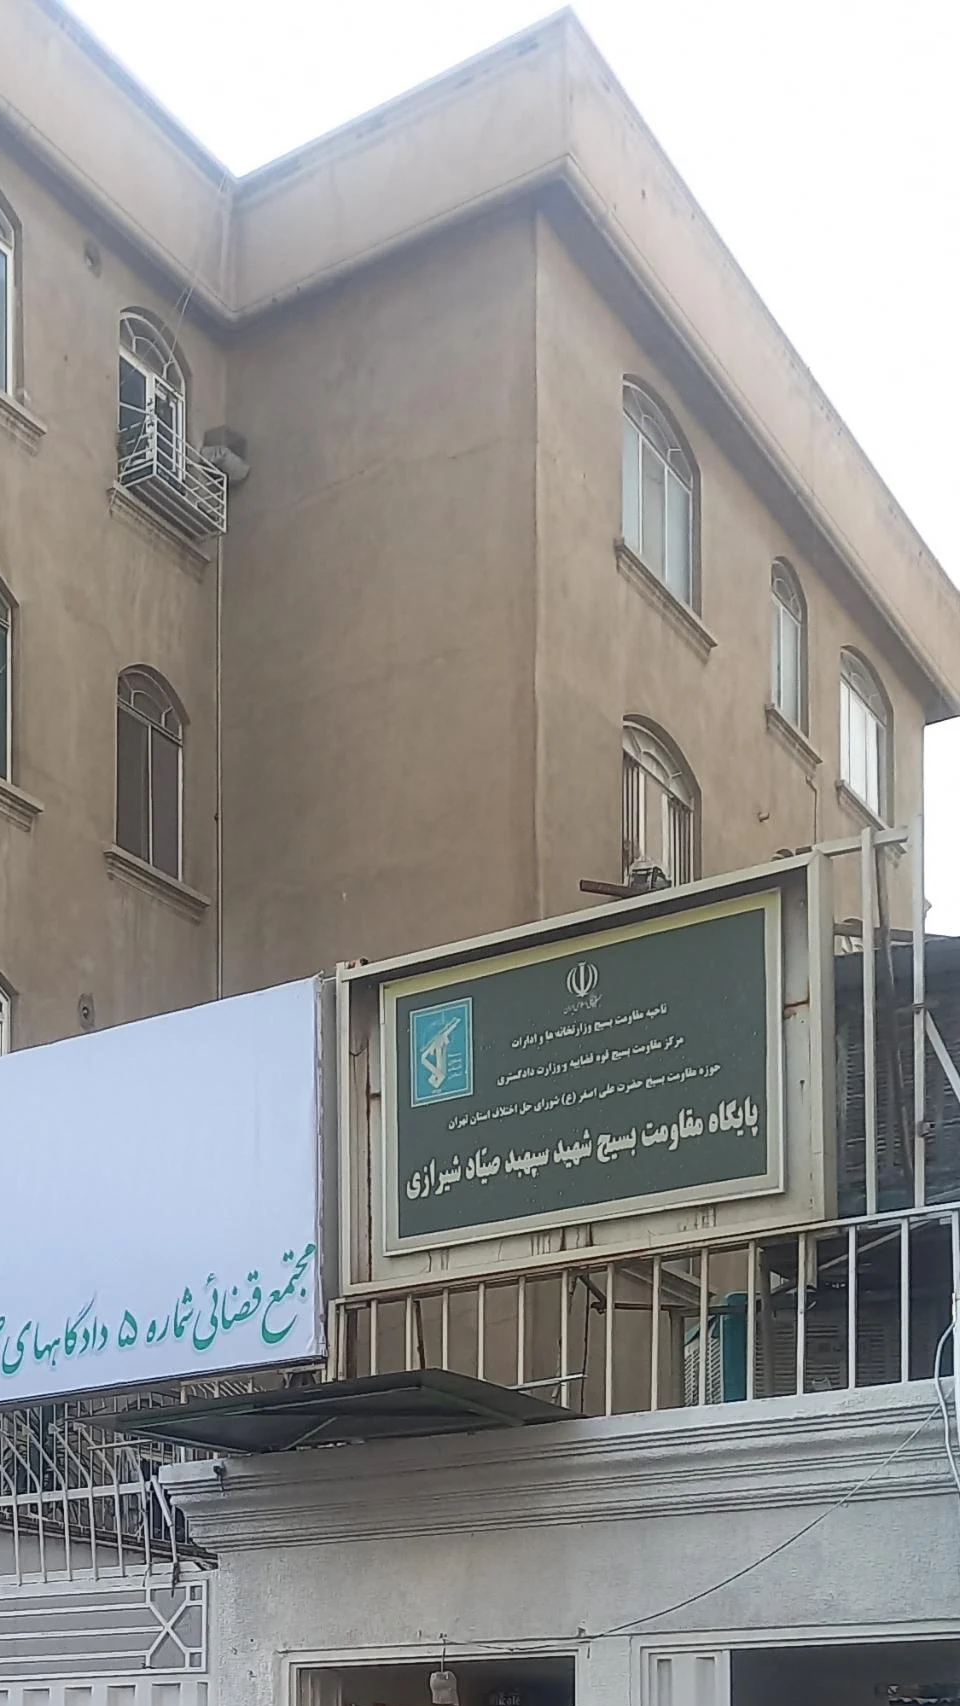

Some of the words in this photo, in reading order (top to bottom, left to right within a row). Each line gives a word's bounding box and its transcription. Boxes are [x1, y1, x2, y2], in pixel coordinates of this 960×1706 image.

[614, 1010, 644, 1025] مقاومت
[645, 1003, 668, 1020] ناحیه
[594, 1018, 613, 1032] بسیج
[511, 1033, 538, 1049] ادارات
[631, 1039, 662, 1055] مقاومت
[663, 1035, 685, 1051] مرکز
[595, 1048, 609, 1064] قوه
[611, 1047, 631, 1061] بسیج
[496, 1066, 535, 1086] دادگستری
[536, 1062, 561, 1077] وزارت
[667, 1067, 697, 1082] مقاومت
[699, 1064, 721, 1078] حوزه
[616, 1080, 643, 1094] حضرت
[645, 1076, 665, 1089] بسیج
[561, 1091, 577, 1106] (ع)
[598, 1083, 615, 1099] علی
[492, 1104, 518, 1118] اختلاف
[519, 1102, 533, 1115] حل
[533, 1096, 560, 1112] شورای
[448, 1114, 469, 1130] تهران
[470, 1110, 491, 1125] استان
[708, 1095, 759, 1137] پایگاه
[641, 1108, 704, 1151] مقاومت
[553, 1128, 592, 1168] شهید
[596, 1127, 637, 1163] بسیج
[504, 1148, 550, 1179] سپهبد
[406, 1154, 462, 1200] شیرازی
[261, 1243, 317, 1345] مجتمع
[146, 1285, 194, 1343] شماره
[118, 1308, 139, 1348] ۵
